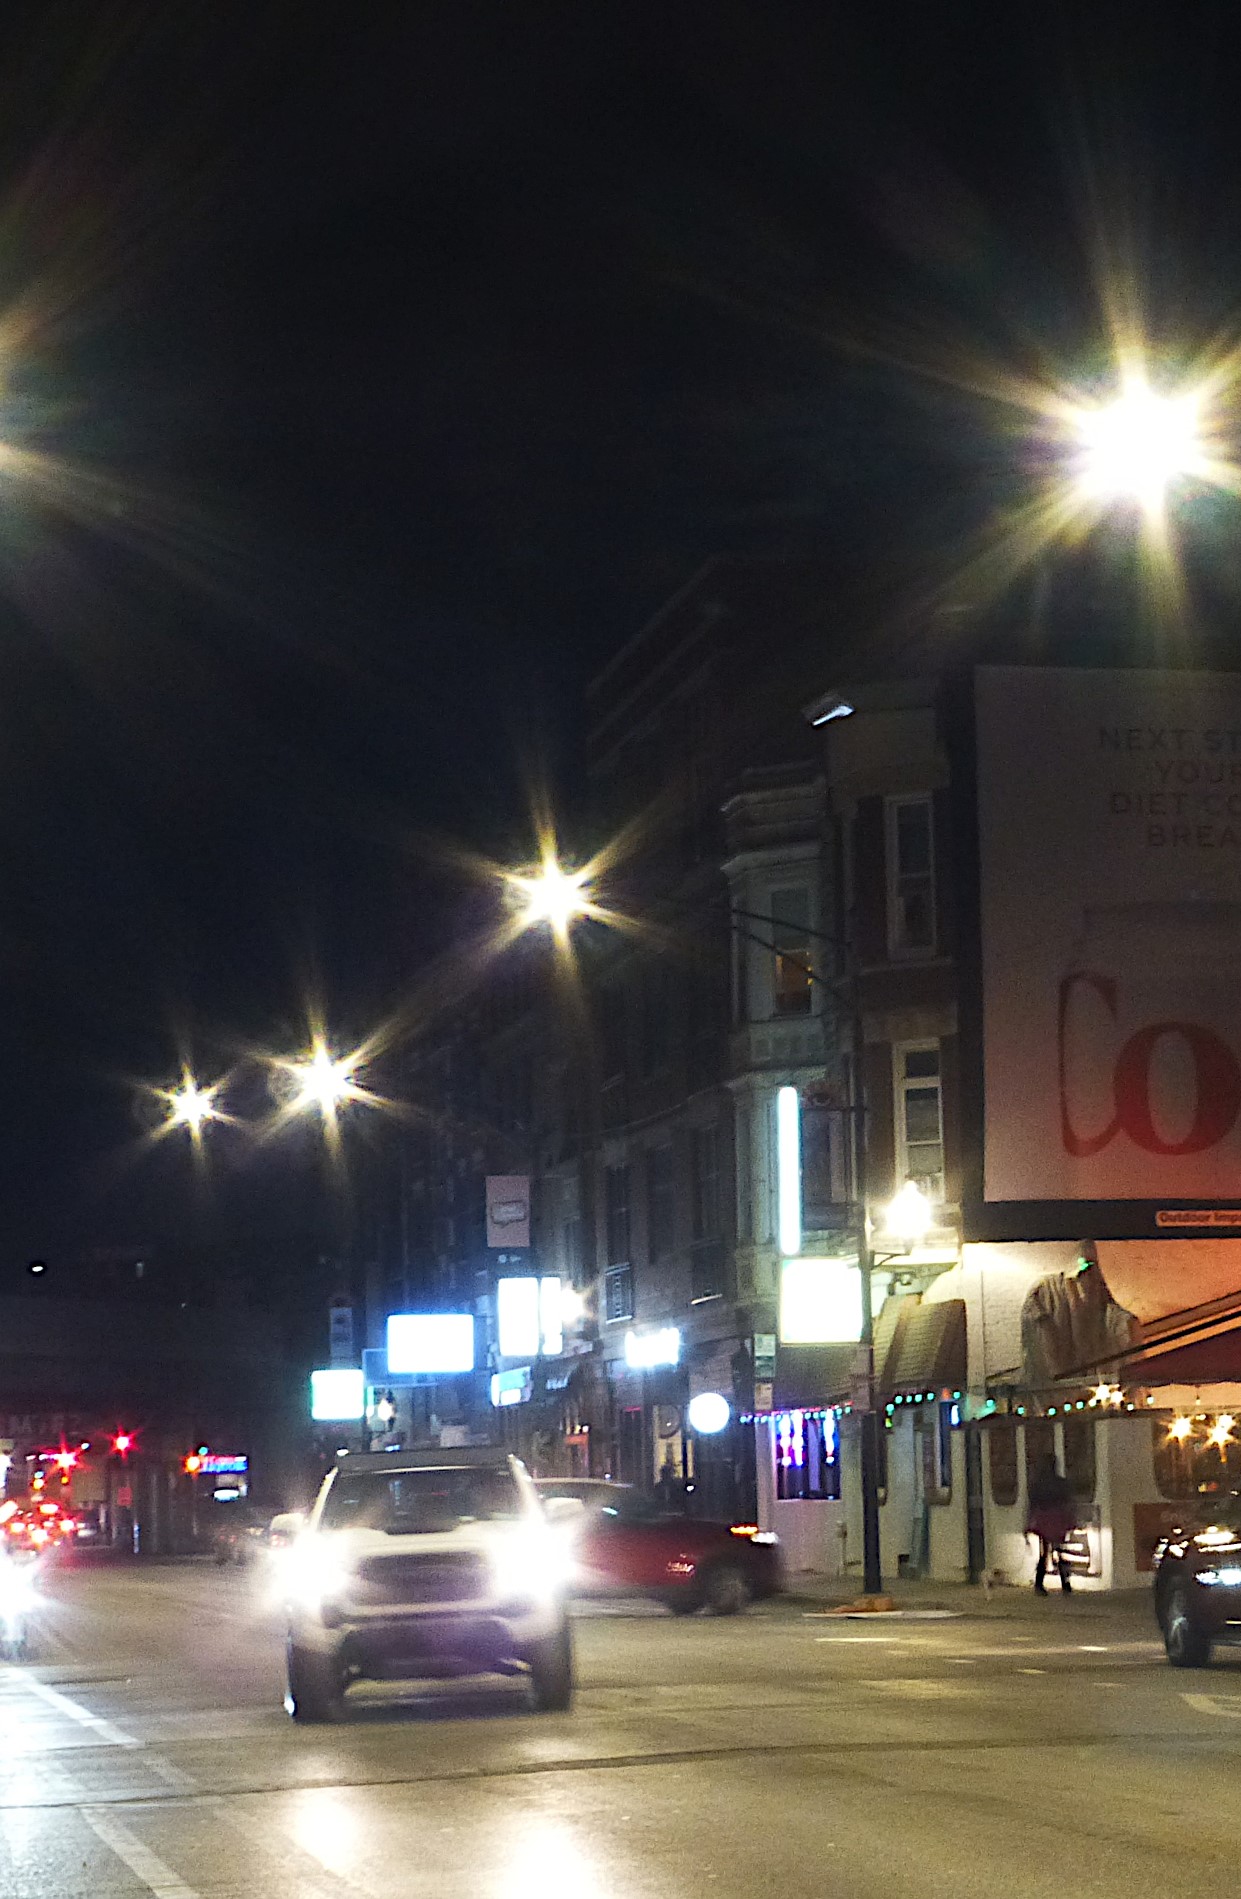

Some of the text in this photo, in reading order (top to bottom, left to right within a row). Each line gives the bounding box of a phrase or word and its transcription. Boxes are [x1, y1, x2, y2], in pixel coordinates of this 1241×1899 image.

[1098, 727, 1193, 752] NEXT
[1109, 791, 1189, 816] DIET
[1159, 1211, 1211, 1223] Outdoor
